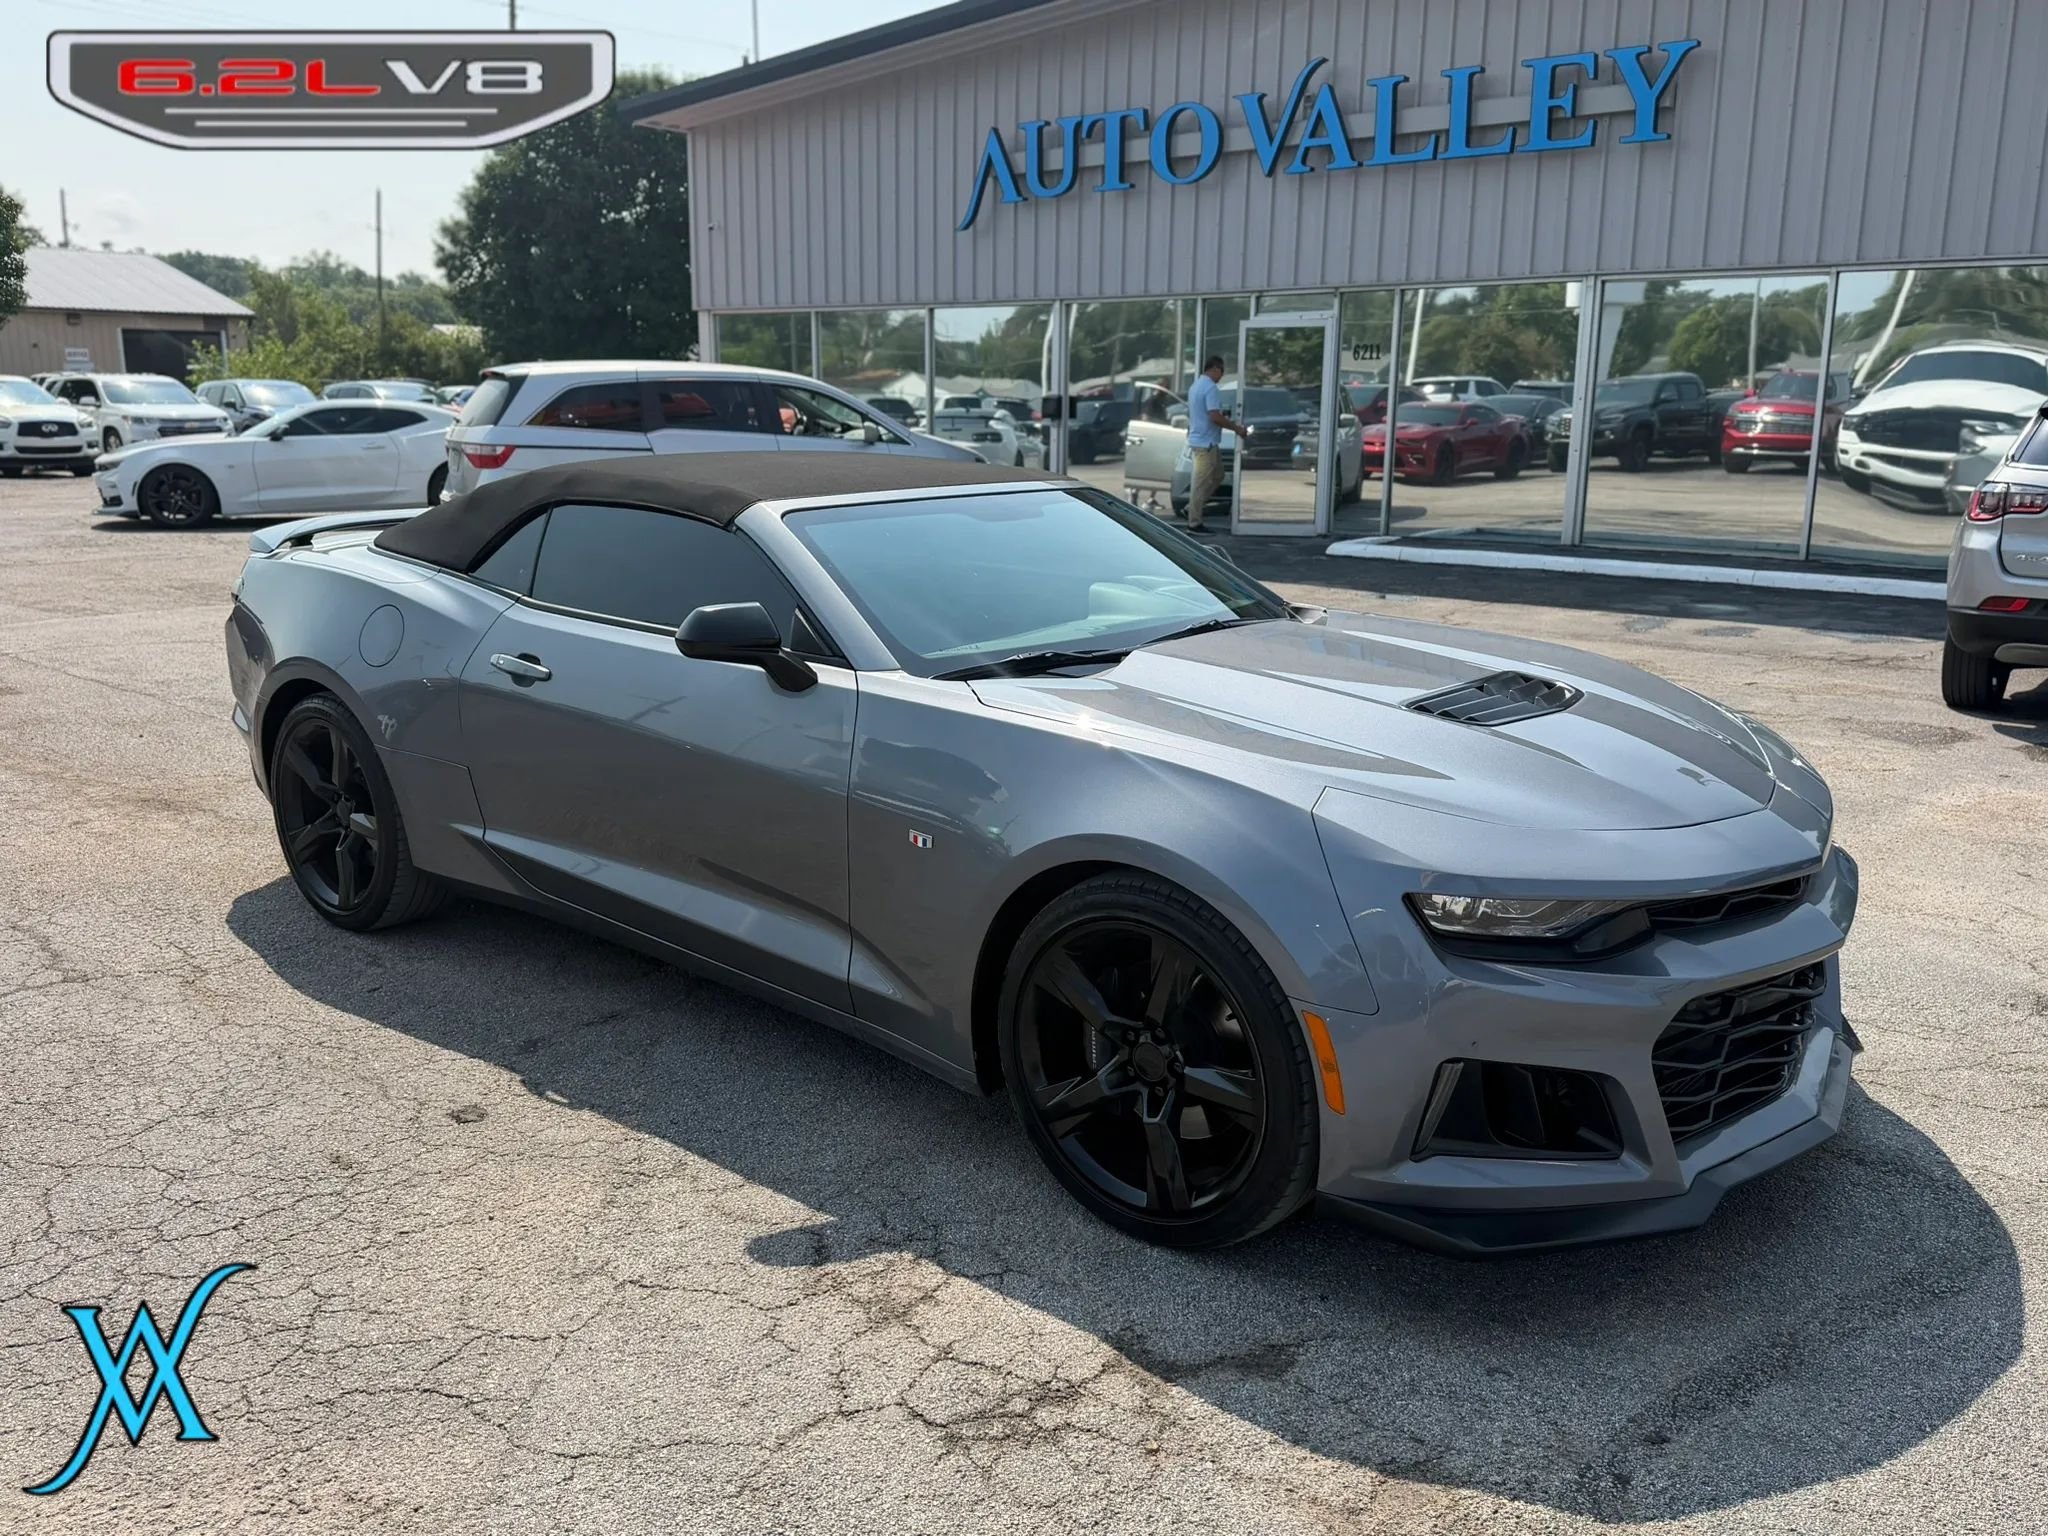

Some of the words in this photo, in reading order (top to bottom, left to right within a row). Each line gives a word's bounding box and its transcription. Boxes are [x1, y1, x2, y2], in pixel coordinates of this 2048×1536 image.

[954, 101, 1225, 232] AUTO
[1232, 38, 1701, 178] VALLEY
[1353, 343, 1381, 361] 6211
